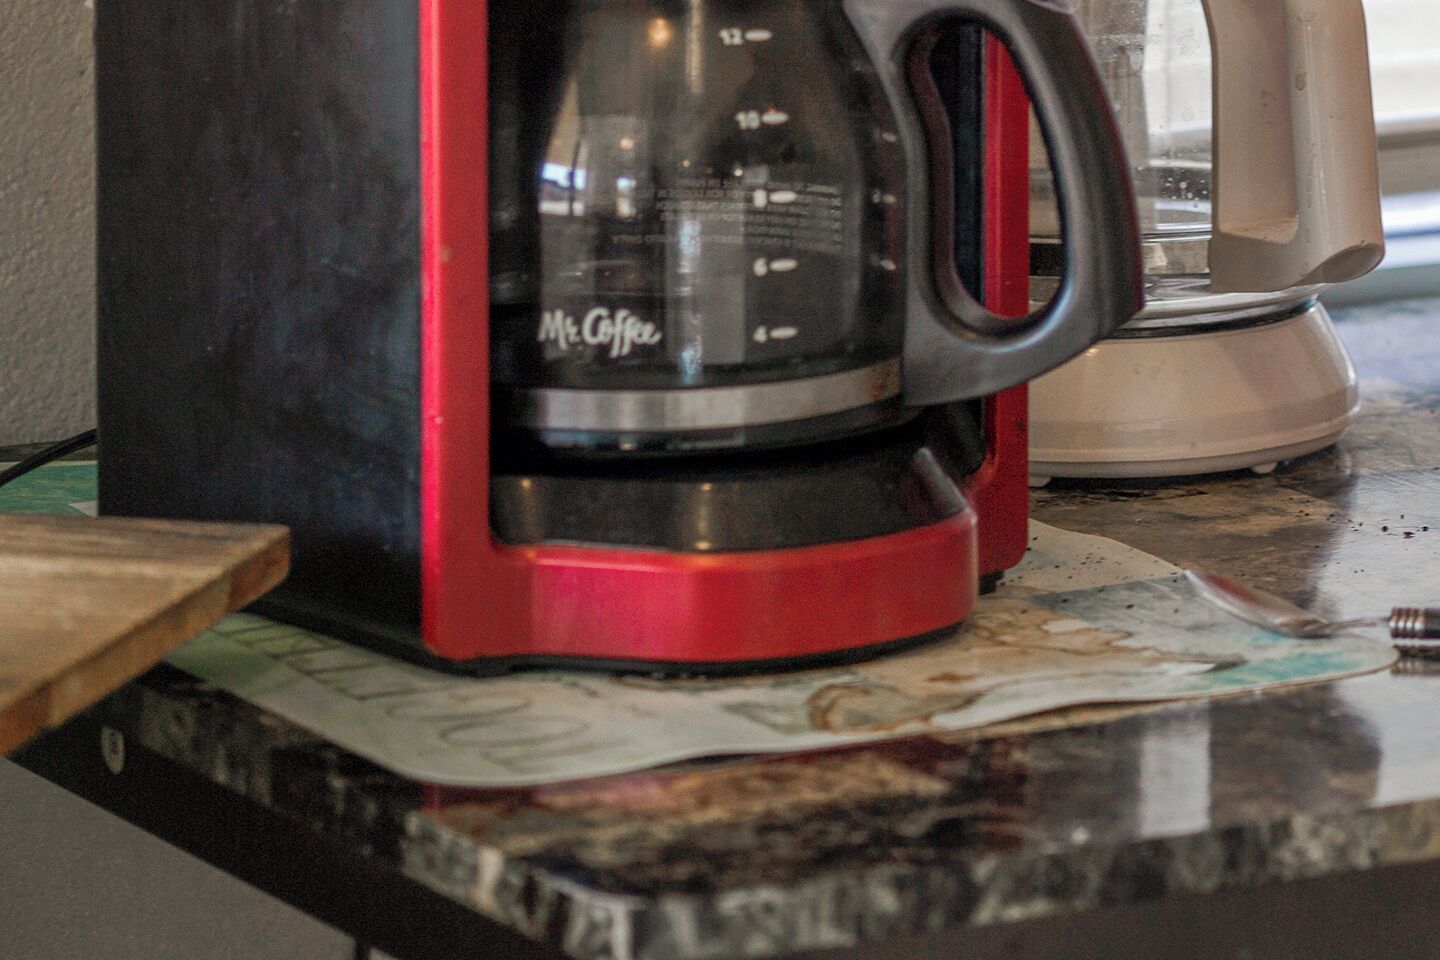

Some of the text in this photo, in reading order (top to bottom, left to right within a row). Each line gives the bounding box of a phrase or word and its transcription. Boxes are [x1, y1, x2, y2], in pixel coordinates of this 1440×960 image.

[718, 27, 744, 46] 12
[734, 110, 761, 130] 10
[753, 189, 767, 209] 8
[753, 256, 768, 276] 6
[582, 306, 662, 359] Coffee
[753, 325, 769, 345] 4
